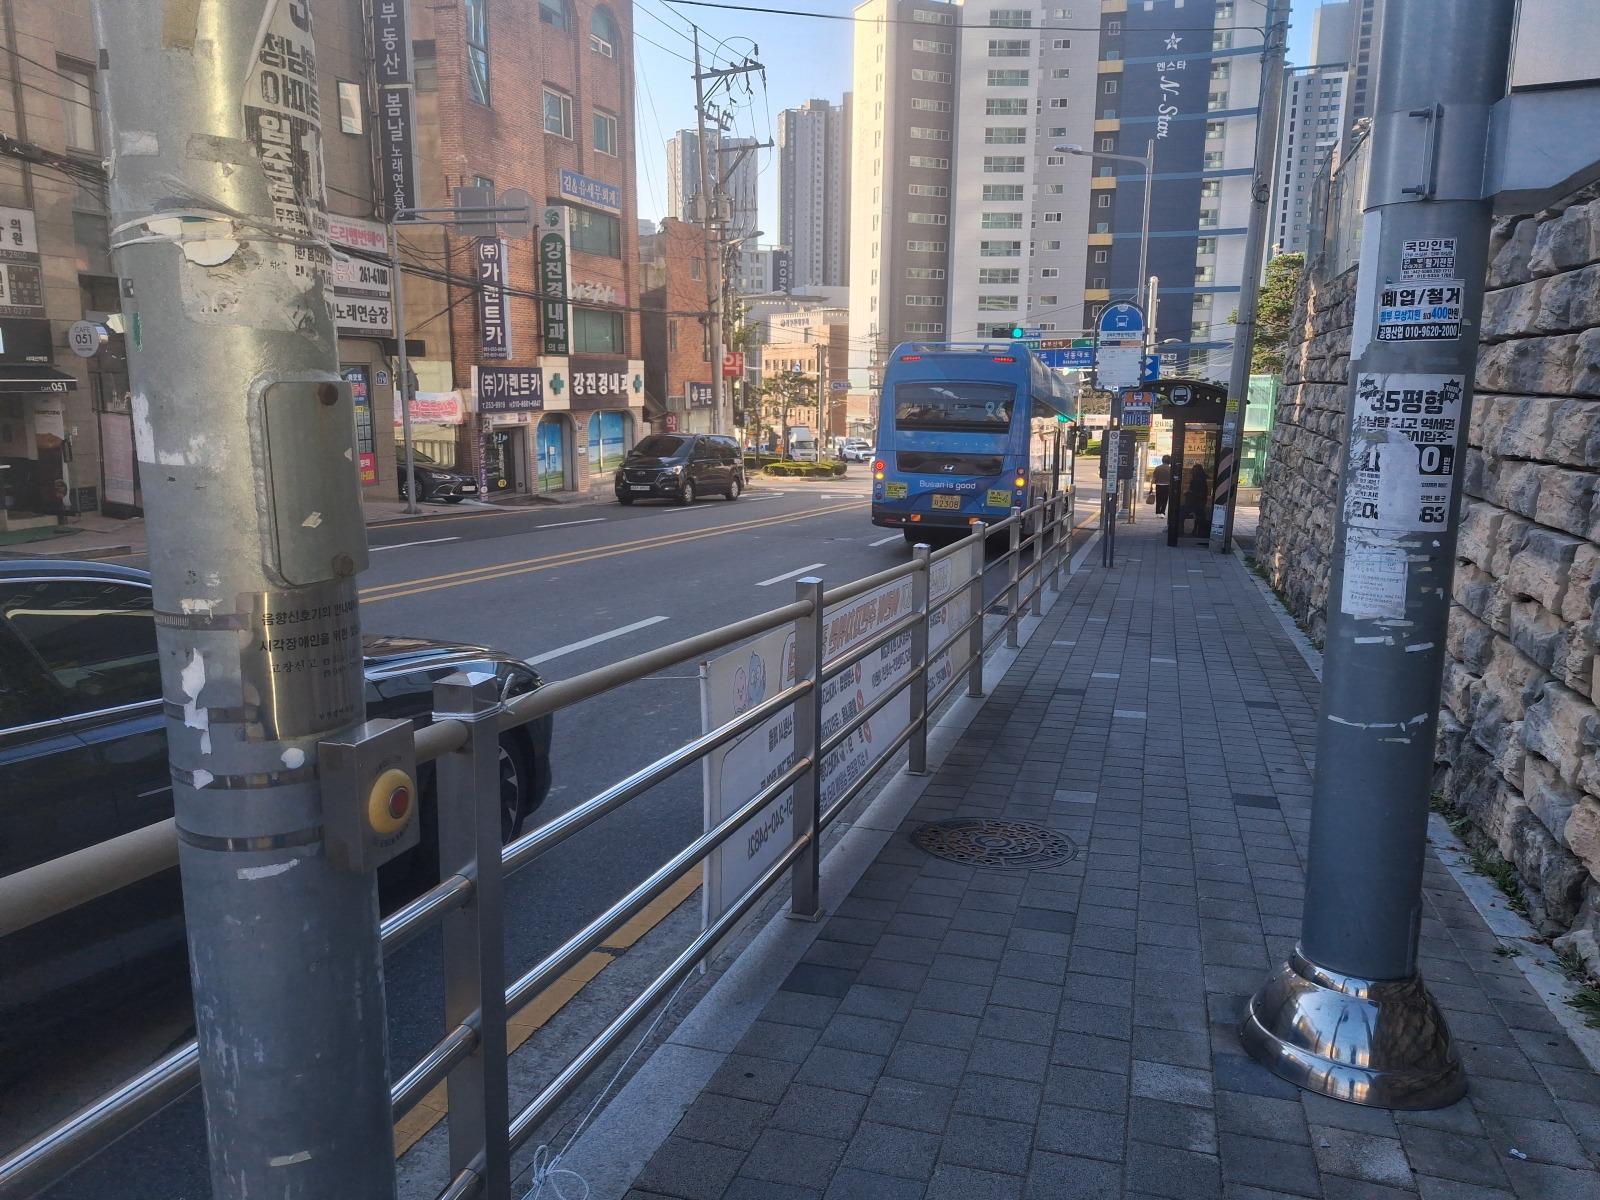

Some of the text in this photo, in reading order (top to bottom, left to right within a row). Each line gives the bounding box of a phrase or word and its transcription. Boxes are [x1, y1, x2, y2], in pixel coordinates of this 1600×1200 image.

[380, 2, 401, 76] 부동산
[1156, 60, 1187, 72] 엔스타
[1405, 240, 1454, 252] 국민인력
[335, 303, 389, 325] 노래연습장
[75, 334, 93, 344] 051
[51, 382, 67, 391] 051
[481, 373, 541, 398] (주)가렌트카
[1371, 389, 1443, 415] 35평형
[1420, 417, 1456, 431] 역세권
[919, 479, 945, 489] Busan
[955, 482, 977, 491] good
[1419, 506, 1446, 523] 63
[260, 632, 330, 652] 시각장애인을
